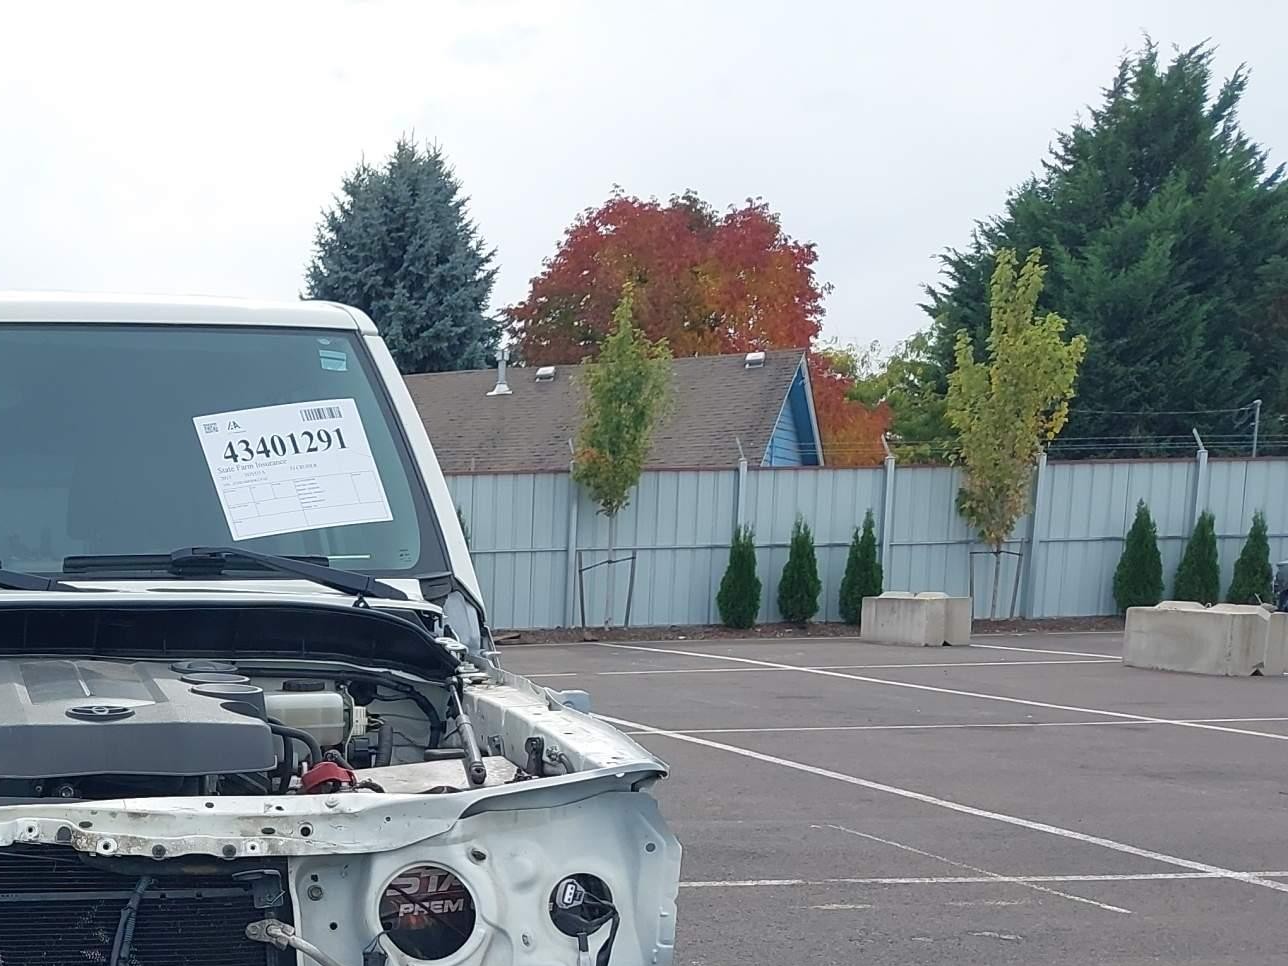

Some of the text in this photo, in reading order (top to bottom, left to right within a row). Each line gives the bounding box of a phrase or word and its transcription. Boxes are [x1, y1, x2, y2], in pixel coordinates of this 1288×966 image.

[223, 427, 347, 463] 43401291
[217, 465, 235, 474] State
[236, 463, 254, 472] Farm
[255, 459, 288, 469] Insurance
